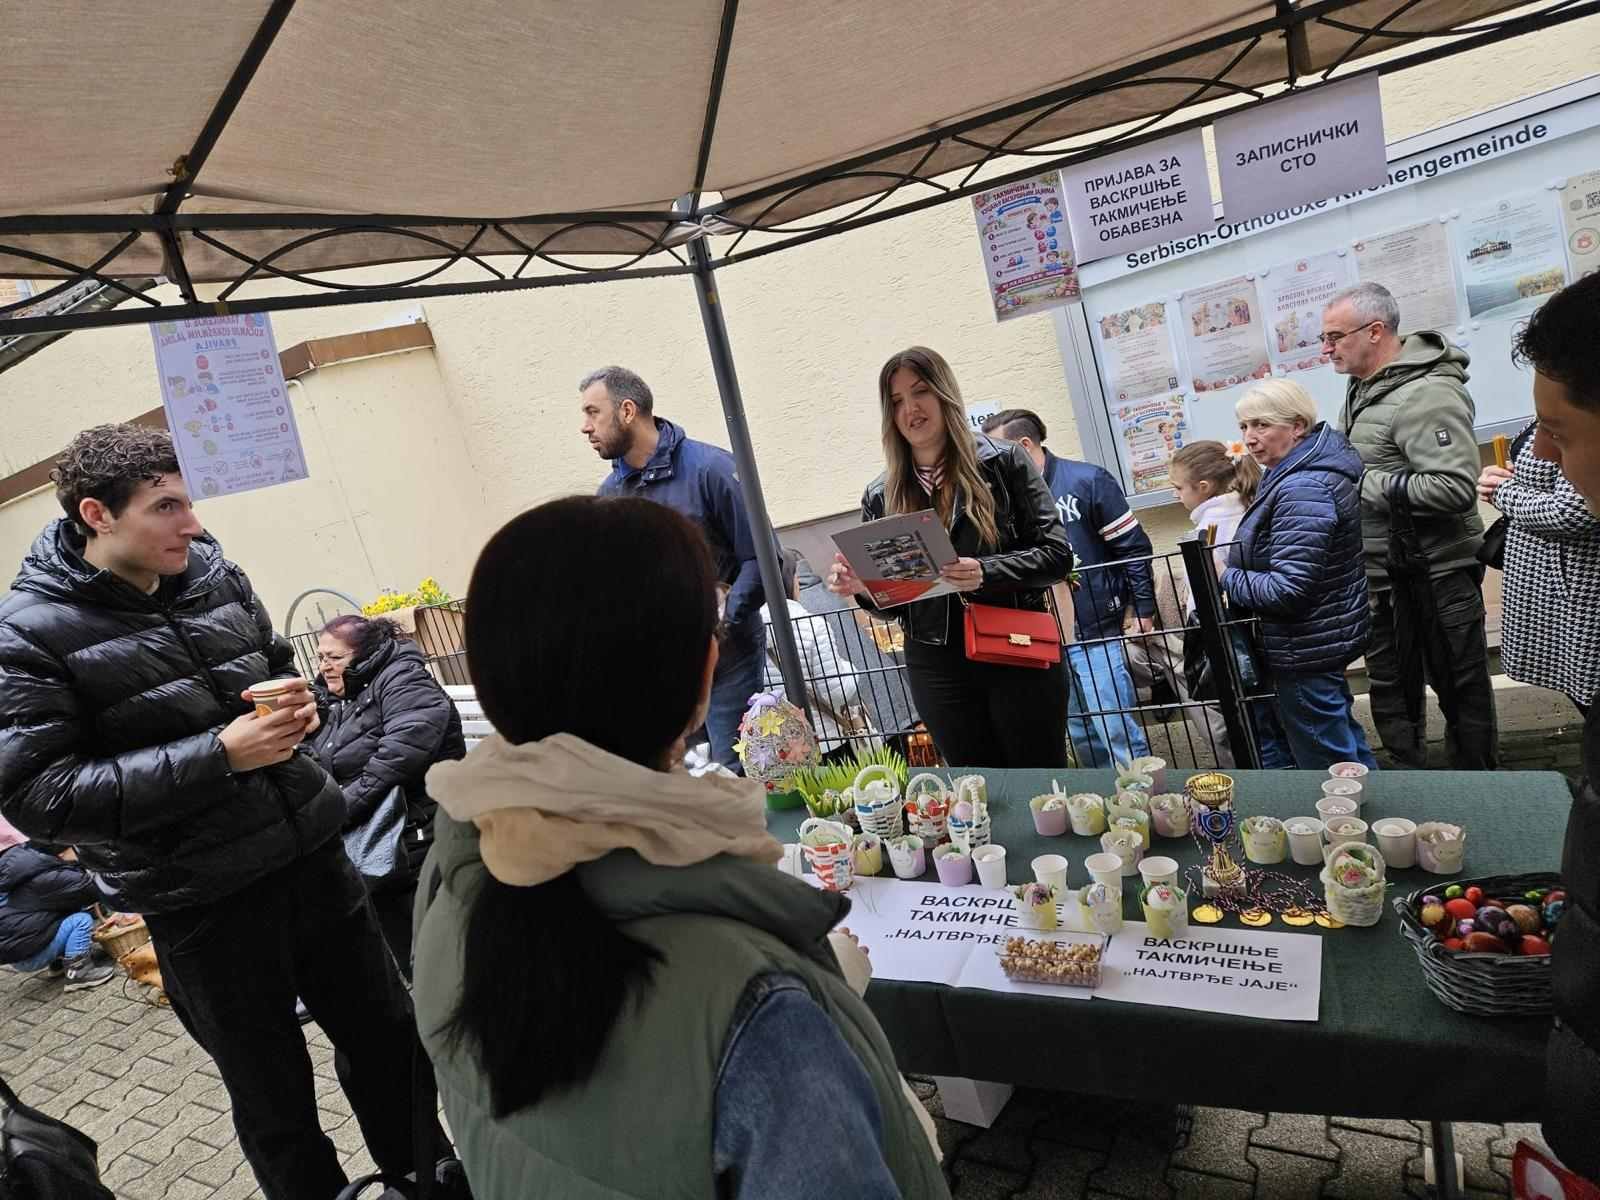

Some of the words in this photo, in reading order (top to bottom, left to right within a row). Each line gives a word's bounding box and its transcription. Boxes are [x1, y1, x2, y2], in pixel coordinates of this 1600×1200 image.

[1235, 119, 1359, 167] ЗАПИСНИЧКИ
[1084, 163, 1155, 194] ПРИЈАВА
[1159, 155, 1182, 172] ЗА
[1280, 152, 1317, 174] СТО
[1335, 123, 1548, 201] engemeinde
[1089, 174, 1182, 209] ВАСКРШЊЕ
[1089, 190, 1188, 227] ТАКМИЧЕЊЕ
[1099, 210, 1184, 242] ОБАВЕЗНА
[1136, 950, 1283, 974] ТАКМИЧЕЊЕ
[1143, 936, 1279, 958] ВАСКРШЊЕ
